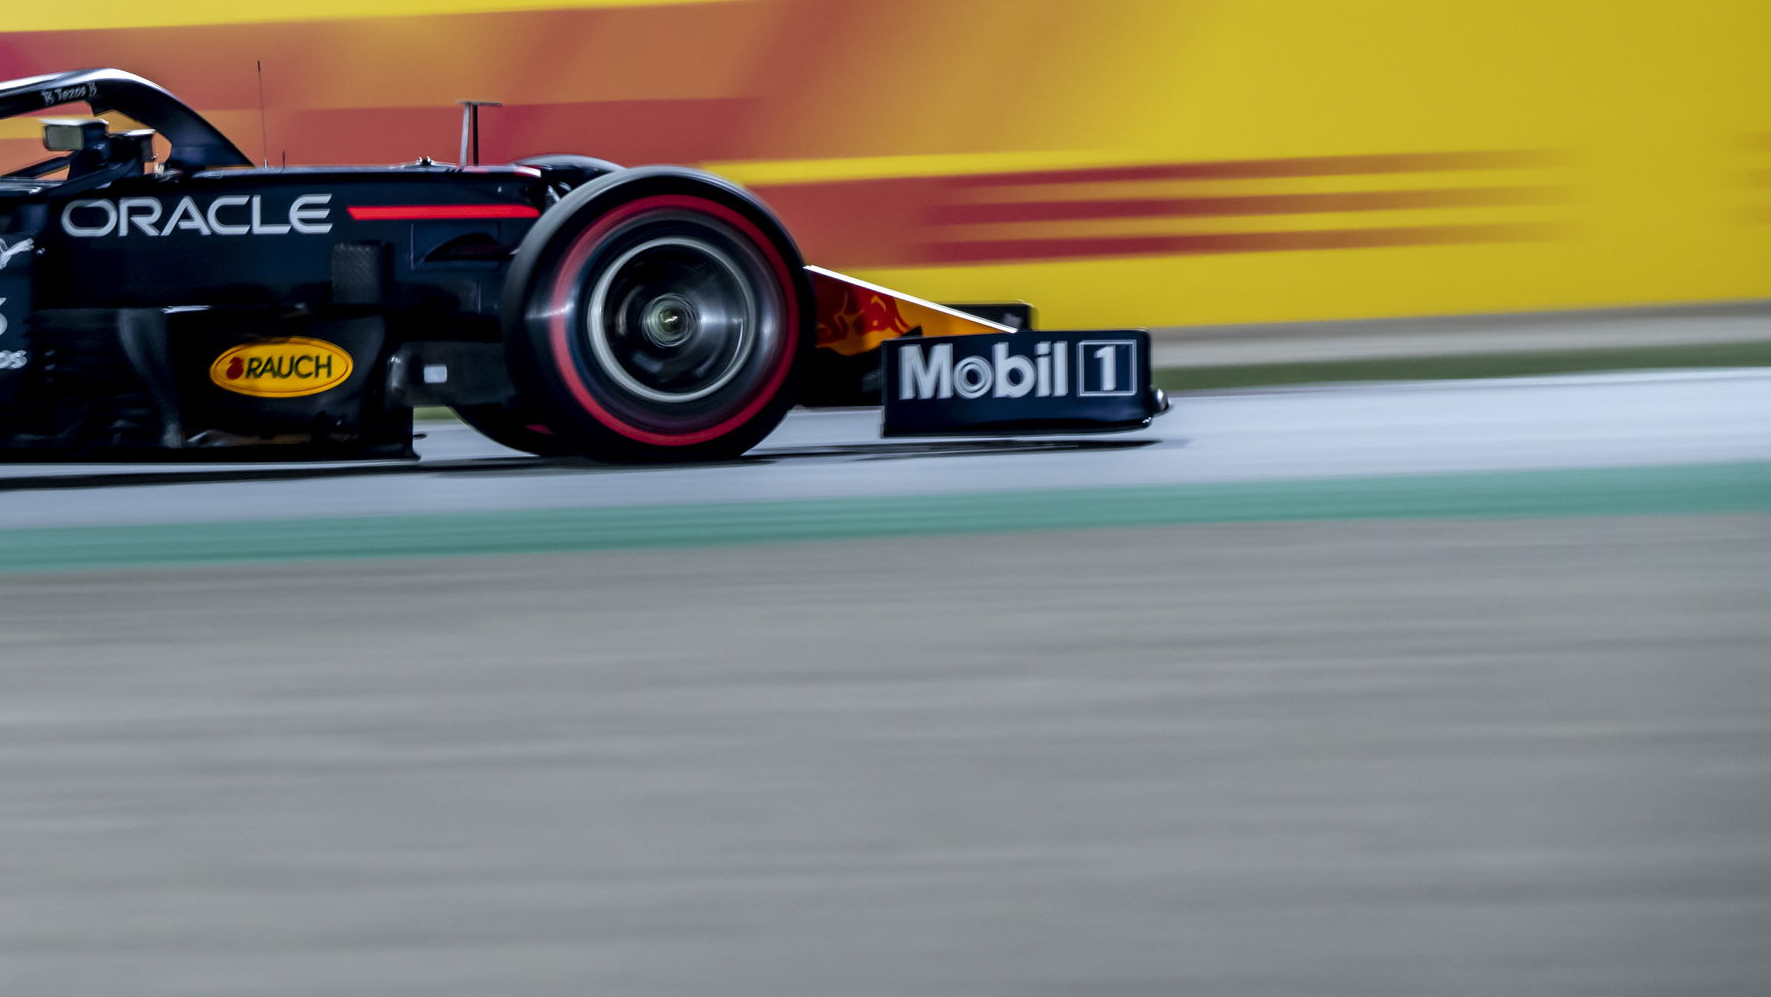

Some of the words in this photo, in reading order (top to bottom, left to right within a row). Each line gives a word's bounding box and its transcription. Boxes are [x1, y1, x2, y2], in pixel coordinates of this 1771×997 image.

[60, 193, 333, 238] ORACLE
[244, 354, 333, 380] RAUCH
[899, 340, 1069, 400] Mobil
